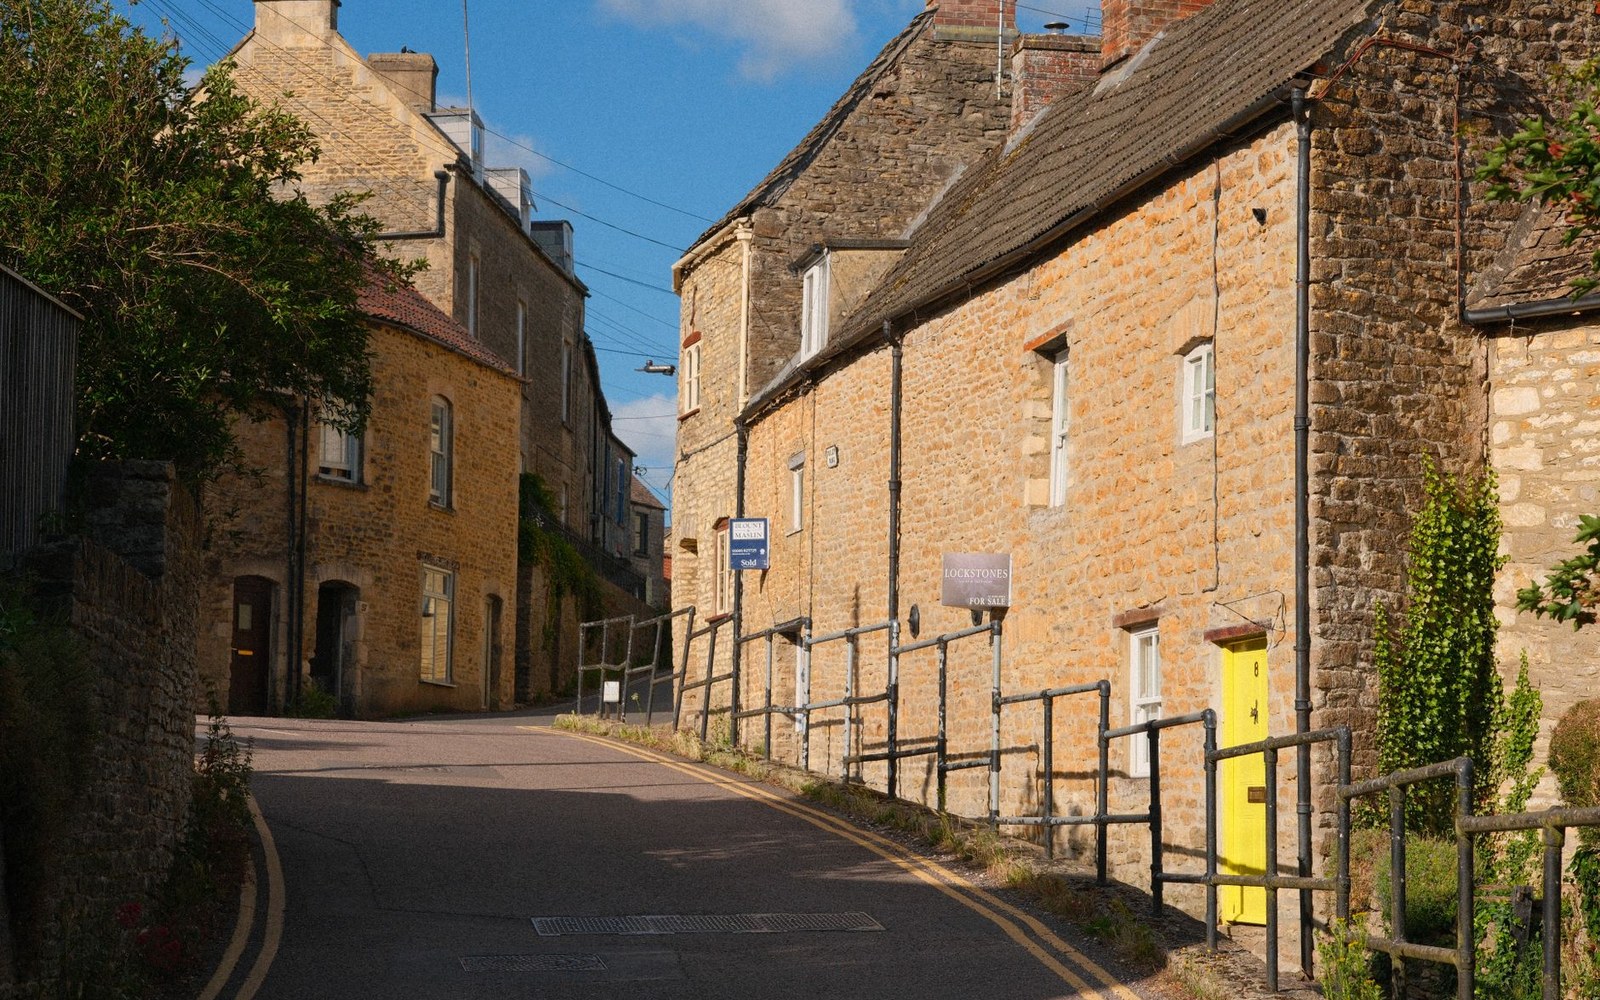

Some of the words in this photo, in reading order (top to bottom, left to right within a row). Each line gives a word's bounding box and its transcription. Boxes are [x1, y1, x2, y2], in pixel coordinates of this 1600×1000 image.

[944, 568, 1008, 578] LOCKSTONES
[969, 597, 985, 605] FOR
[987, 598, 1006, 606] SALE
[1254, 661, 1259, 677] 8
